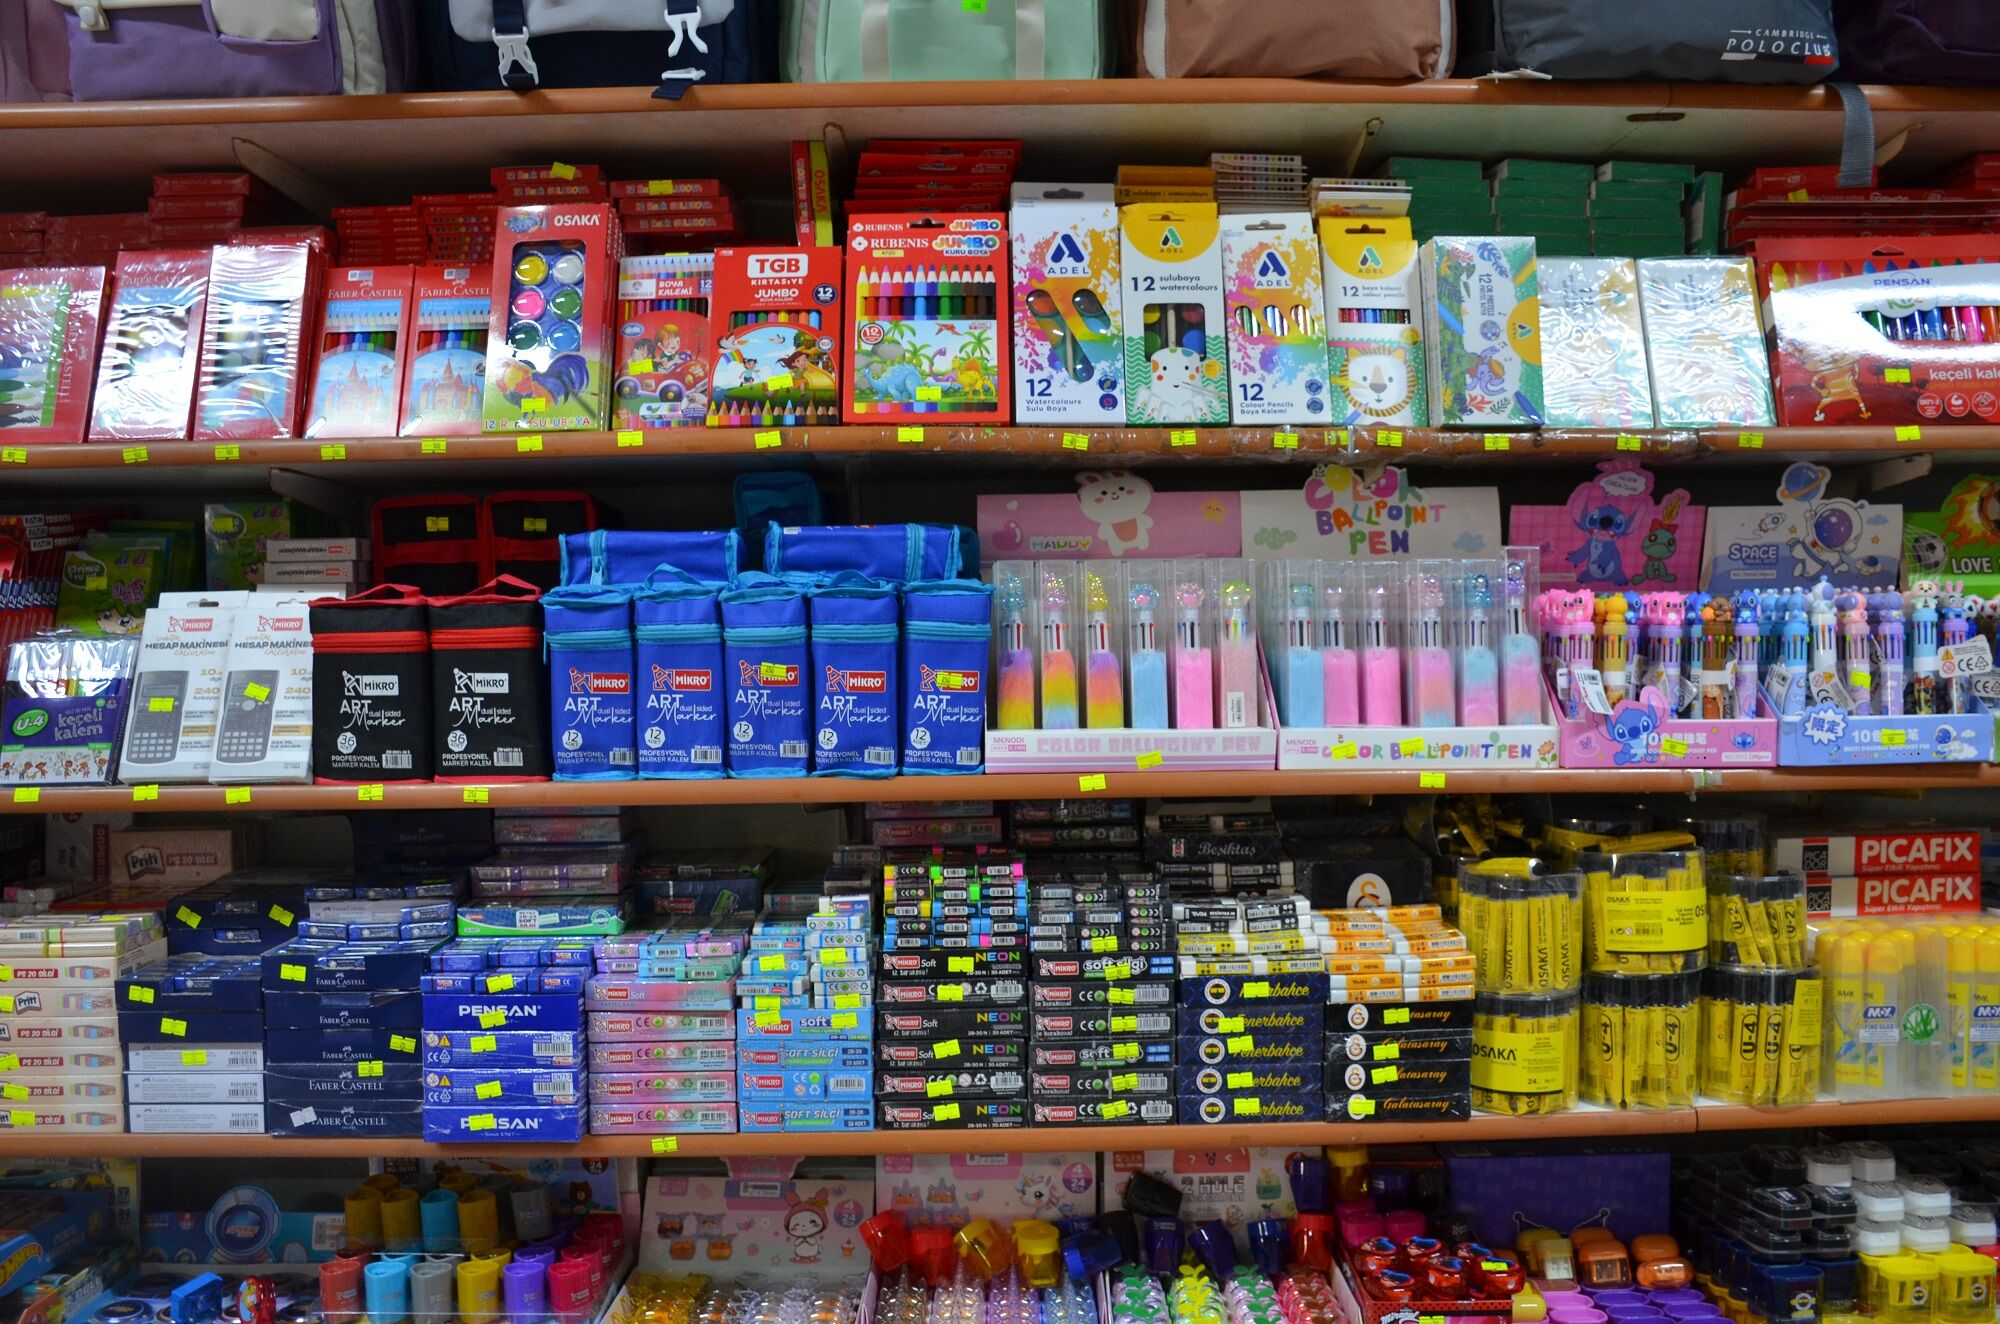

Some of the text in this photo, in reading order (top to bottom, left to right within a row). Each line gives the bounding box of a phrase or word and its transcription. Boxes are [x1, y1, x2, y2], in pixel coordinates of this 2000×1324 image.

[1755, 28, 1815, 40] CAMBRIDGE
[1726, 38, 1832, 57] POLO CLUB
[554, 214, 600, 227] OSAKA
[864, 219, 1002, 231] RUBENIS JUMBO
[870, 235, 1001, 250] RUBENIS JUMBO
[755, 257, 800, 274] TGB
[1047, 266, 1090, 275] ADEL
[658, 279, 713, 289] BOYA 12
[1131, 274, 1201, 292] 12 suluboya
[1159, 283, 1219, 292] watercolours
[1256, 279, 1291, 288] ADEL
[1873, 278, 1931, 287] PENSAN
[754, 288, 800, 299] JUMBO
[817, 287, 833, 298] 12
[1341, 286, 1359, 297] 12
[866, 327, 881, 337] 12
[1929, 367, 1973, 382] keçeli
[1025, 378, 1052, 397] 12
[1239, 383, 1265, 401] 12
[1025, 398, 1082, 406] Watercolours
[1240, 401, 1294, 410] Colour Pencils
[1046, 405, 1067, 413] Boya
[1240, 407, 1288, 416] Boya Kalemi
[484, 420, 496, 430] 12
[1315, 499, 1447, 536] BALLPOINT
[1350, 530, 1410, 555] PEN
[1729, 545, 1778, 560] SPACE
[1951, 557, 1992, 575] LOVE
[185, 620, 211, 630] MİKRO
[275, 619, 301, 630] MİKRO
[145, 641, 179, 650] HESAP
[235, 641, 270, 650] HESAP
[364, 678, 397, 691] MİKRO
[476, 677, 505, 689] MİKRO
[593, 676, 626, 688] MİKRO
[676, 674, 708, 686] MİKRO
[850, 675, 883, 687] MİKRO
[195, 687, 221, 695] 240
[735, 689, 772, 704] ART
[340, 699, 373, 714] ART
[449, 697, 484, 712] ART
[564, 697, 602, 712] ART
[647, 694, 684, 709] ART
[820, 695, 857, 710] ART
[913, 694, 951, 710] ART
[650, 701, 717, 726] Marker
[738, 697, 805, 720] Marker
[16, 713, 46, 729] U-4
[57, 709, 104, 729] keçeli
[343, 706, 406, 731] Marker
[452, 705, 516, 729] Marker
[568, 704, 635, 728] Marker
[824, 703, 890, 727] Marker
[918, 704, 982, 727] Marker
[737, 723, 750, 735] 12
[1810, 716, 1840, 734] 限定
[54, 723, 104, 742] kalem
[450, 732, 466, 744] 36
[565, 731, 579, 742] 12
[648, 728, 662, 740] 12
[821, 730, 834, 741] 12
[914, 730, 927, 741] 12
[339, 734, 355, 746] 36
[728, 743, 776, 751] PROFESYONEL
[1497, 743, 1532, 760] PEN
[1804, 851, 1829, 861] PICA
[1861, 836, 1974, 865] PICAFIX
[130, 853, 158, 868] Pritt
[1804, 860, 1827, 870] DOR
[1807, 891, 1830, 901] PICA
[1864, 876, 1974, 905] PICAFIX
[1606, 896, 1630, 904] OSAKA
[1807, 901, 1831, 911] DOR
[1864, 904, 1885, 913] Süper
[921, 951, 1021, 968] Soft NEON
[1539, 946, 1549, 988] OSAKA
[27, 970, 37, 978] 20
[17, 995, 38, 1007] Pritt
[631, 990, 645, 1000] Soft
[800, 1016, 827, 1026] soft
[923, 1012, 1021, 1028] Soft NEON
[1742, 1020, 1756, 1055] U-4
[1766, 1020, 1781, 1055] U-4
[785, 1048, 812, 1058] SOFT
[919, 1044, 1018, 1059] Soft NEON
[1472, 1044, 1519, 1059] OSAKA
[309, 1079, 385, 1092] FABER-CASTELL
[784, 1109, 812, 1119] SOFT
[975, 1105, 1021, 1115] NEON
[460, 1117, 539, 1130] PSAN
[1181, 1175, 1246, 1195] 2 HOLE
